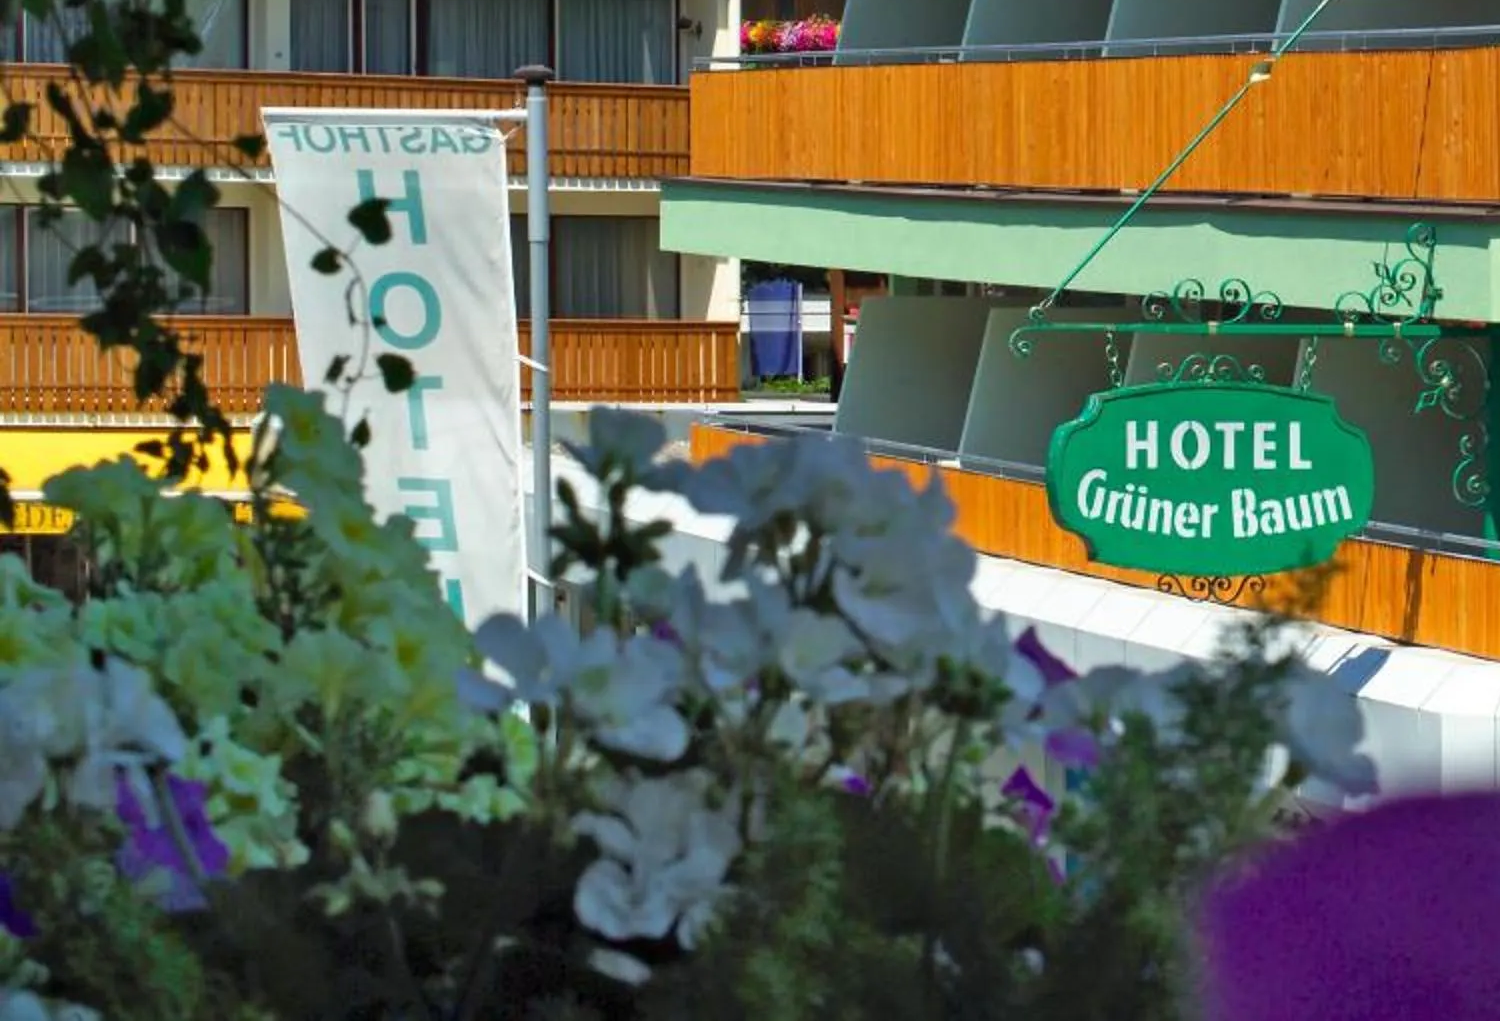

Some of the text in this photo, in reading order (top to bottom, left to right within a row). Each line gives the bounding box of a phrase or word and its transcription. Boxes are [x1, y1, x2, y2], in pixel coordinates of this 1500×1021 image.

[1125, 420, 1313, 470] HOTEL
[1076, 468, 1353, 539] Grüner Baum
